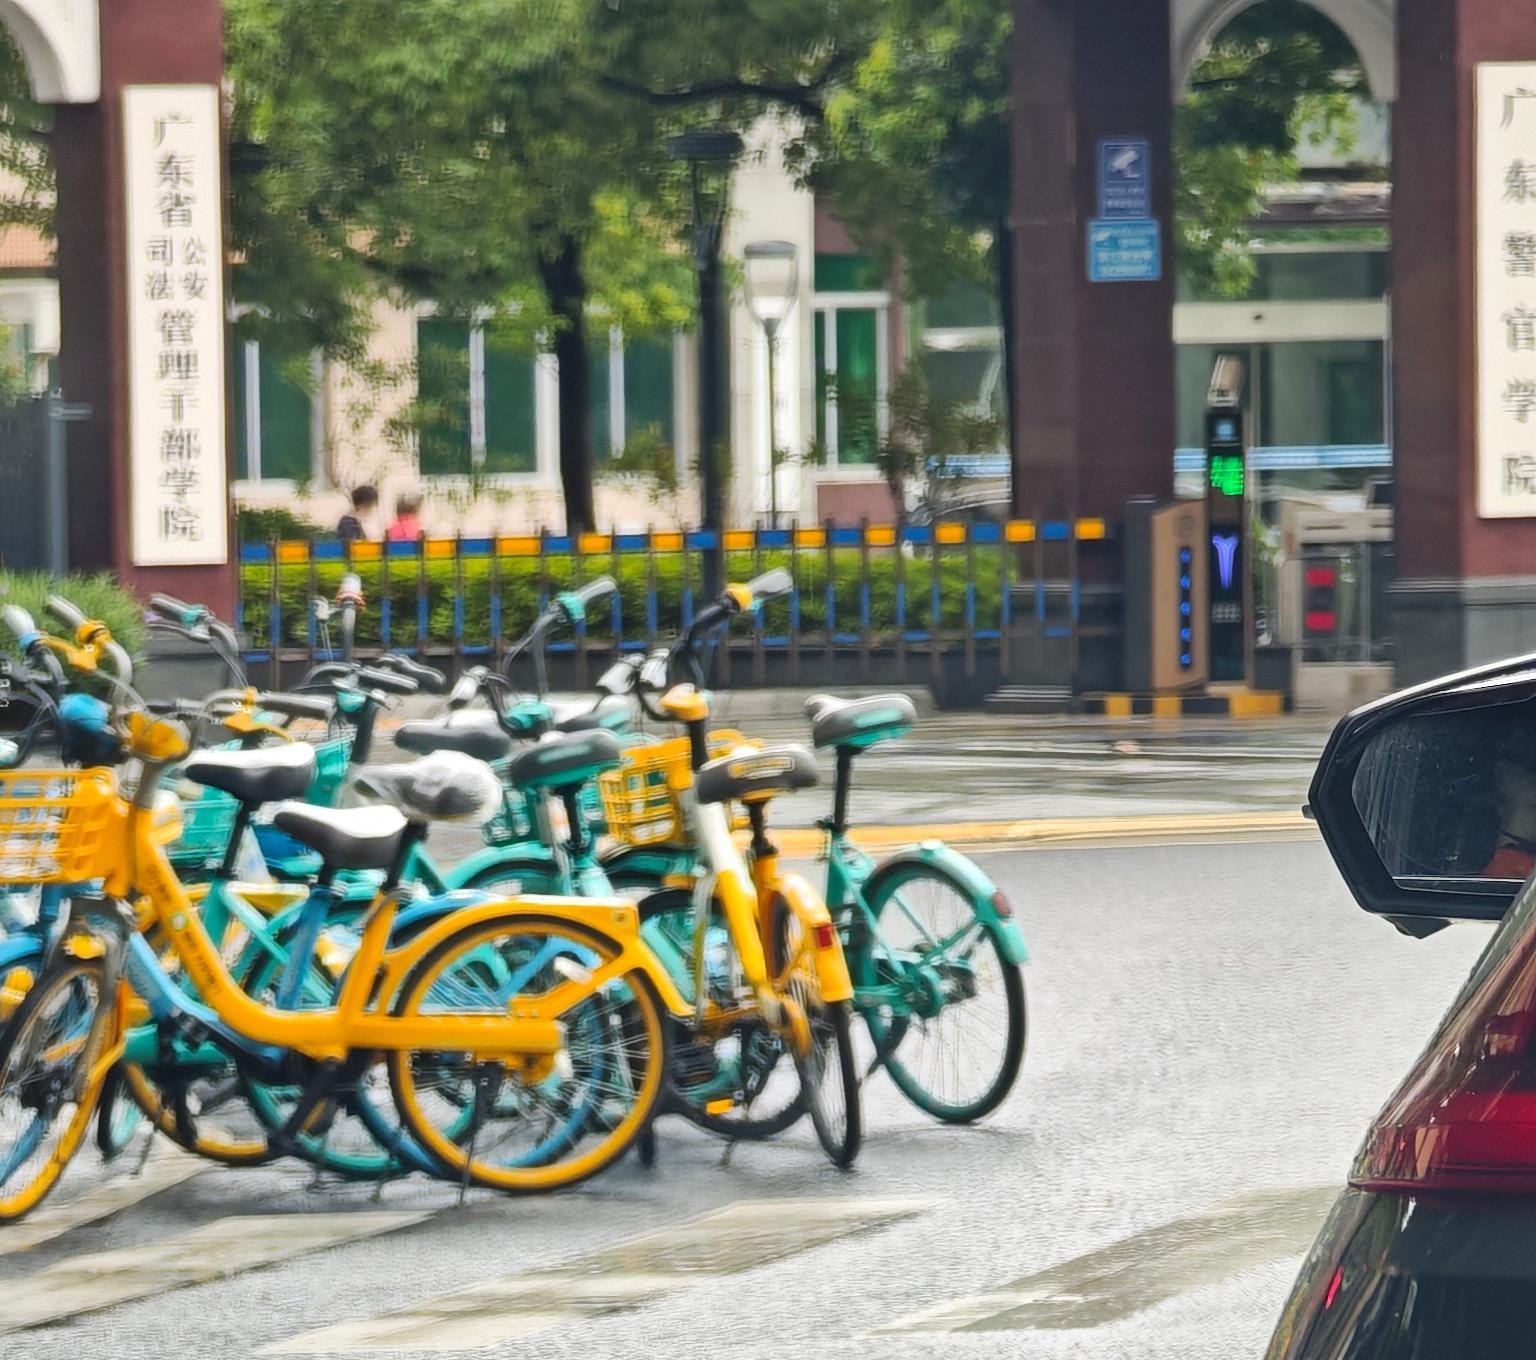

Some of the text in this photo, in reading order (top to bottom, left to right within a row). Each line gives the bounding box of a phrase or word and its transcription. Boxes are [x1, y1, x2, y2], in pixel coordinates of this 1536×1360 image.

[153, 112, 195, 228] 广东省
[1500, 87, 1536, 496] 广东警官学院
[155, 309, 204, 543] 管理干部学院
